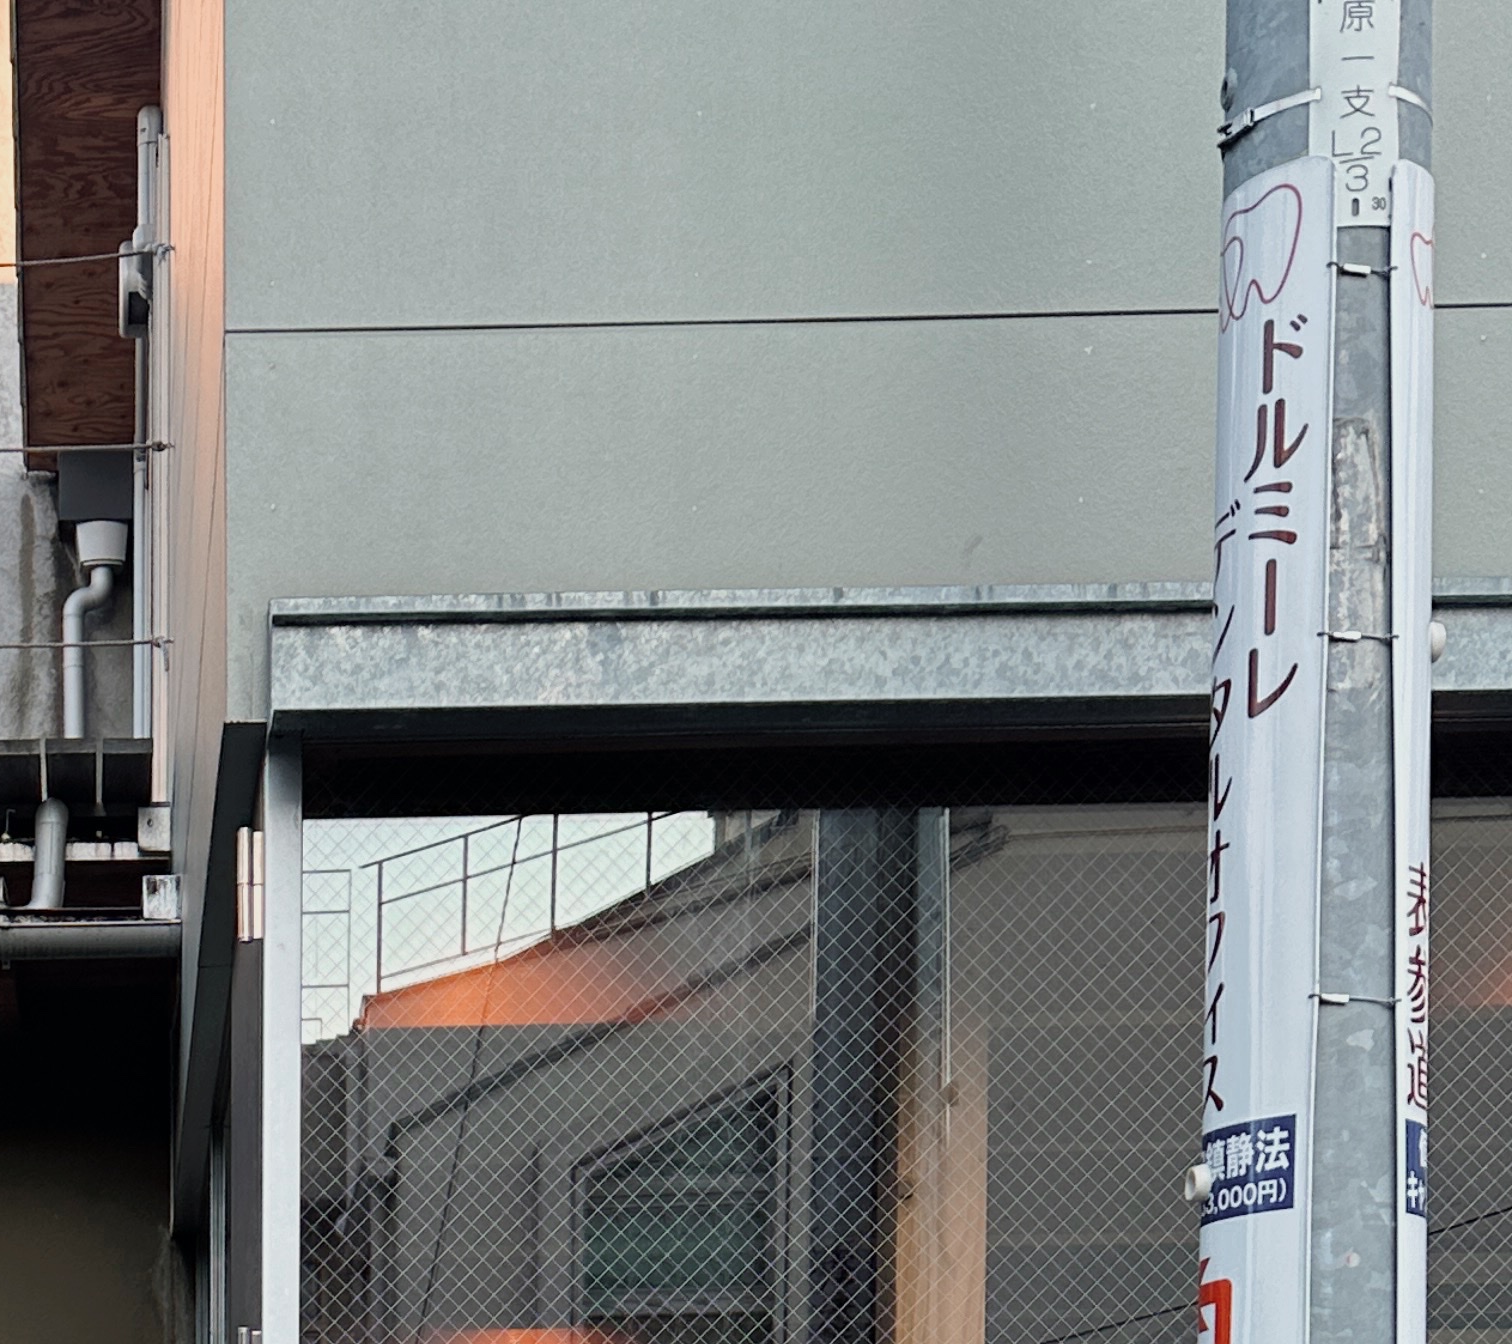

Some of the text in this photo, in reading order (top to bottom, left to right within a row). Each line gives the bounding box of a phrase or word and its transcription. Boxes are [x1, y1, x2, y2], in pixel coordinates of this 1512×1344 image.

[1243, 313, 1309, 719] ドルミーレ
